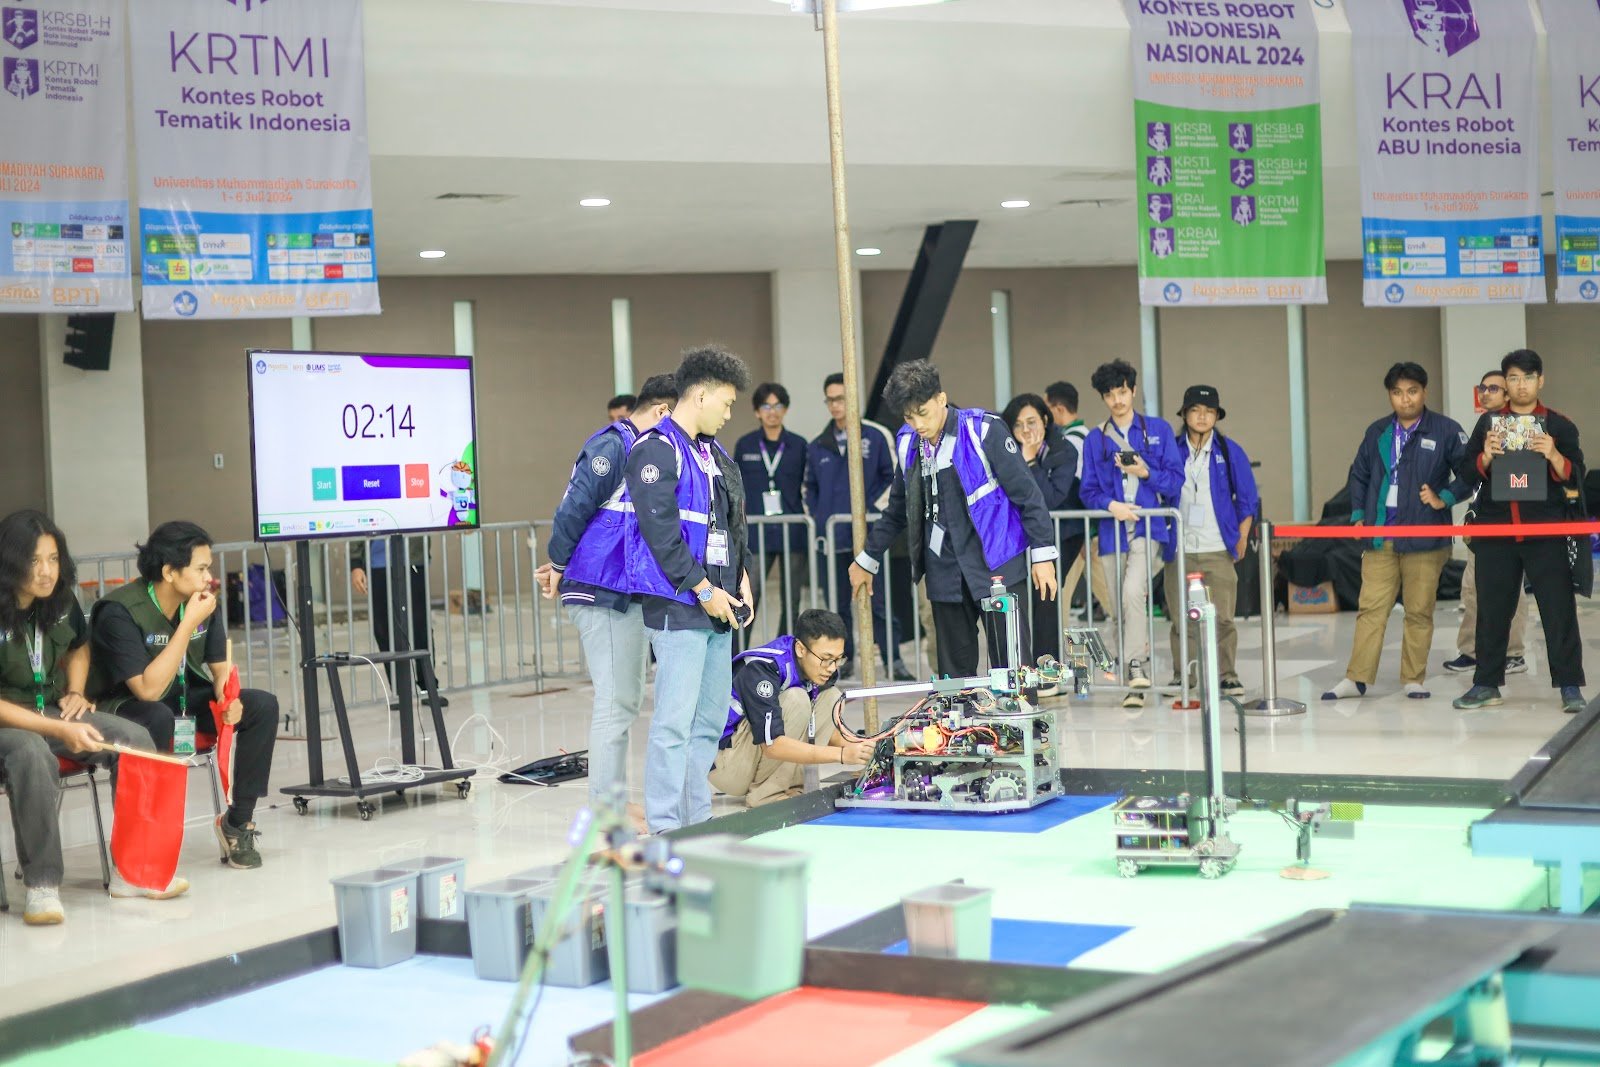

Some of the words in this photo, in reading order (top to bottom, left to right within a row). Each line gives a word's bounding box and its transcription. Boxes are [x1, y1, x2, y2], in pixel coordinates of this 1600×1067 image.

[1140, 0, 1220, 17] KONTES
[1225, 3, 1295, 19] ROBOT
[42, 9, 111, 29] KRSBI-H
[1167, 20, 1281, 40] INDONESIA
[170, 31, 329, 78] KRTMI
[1146, 43, 1252, 64] NASIONAL
[1256, 47, 1305, 65] 2024
[43, 60, 99, 78] KRTMI
[181, 86, 256, 106] Kontes
[261, 89, 324, 108] Robot
[1386, 72, 1502, 109] KRAI
[155, 109, 242, 130] Tematik
[249, 113, 351, 132] Indonesia
[1174, 122, 1212, 134] KRSRI
[1255, 122, 1305, 134] KRSBI-B
[1383, 117, 1450, 133] Kontes
[1456, 117, 1515, 133] Robot
[1377, 139, 1420, 155] ABU
[1426, 137, 1521, 155] Indonesia
[1174, 156, 1210, 169] KRSTI
[1257, 158, 1308, 170] KRSBI-H
[49, 165, 104, 181] SURAKARTA
[14, 180, 41, 193] 2024
[153, 177, 213, 189] Universitas
[217, 178, 303, 193] Muhammadiyah
[305, 179, 357, 190] Surakarta
[1175, 193, 1205, 205] KRAI
[1258, 194, 1299, 208] KRTMI
[1177, 226, 1217, 239] KRBAI
[106, 245, 123, 253] BNI
[353, 250, 370, 260] BNI
[53, 287, 100, 304] BPTI
[312, 363, 326, 371] UMS
[342, 403, 415, 439] 02:14
[316, 481, 332, 490] Start
[363, 479, 380, 488] Reset
[410, 478, 424, 487] Stop
